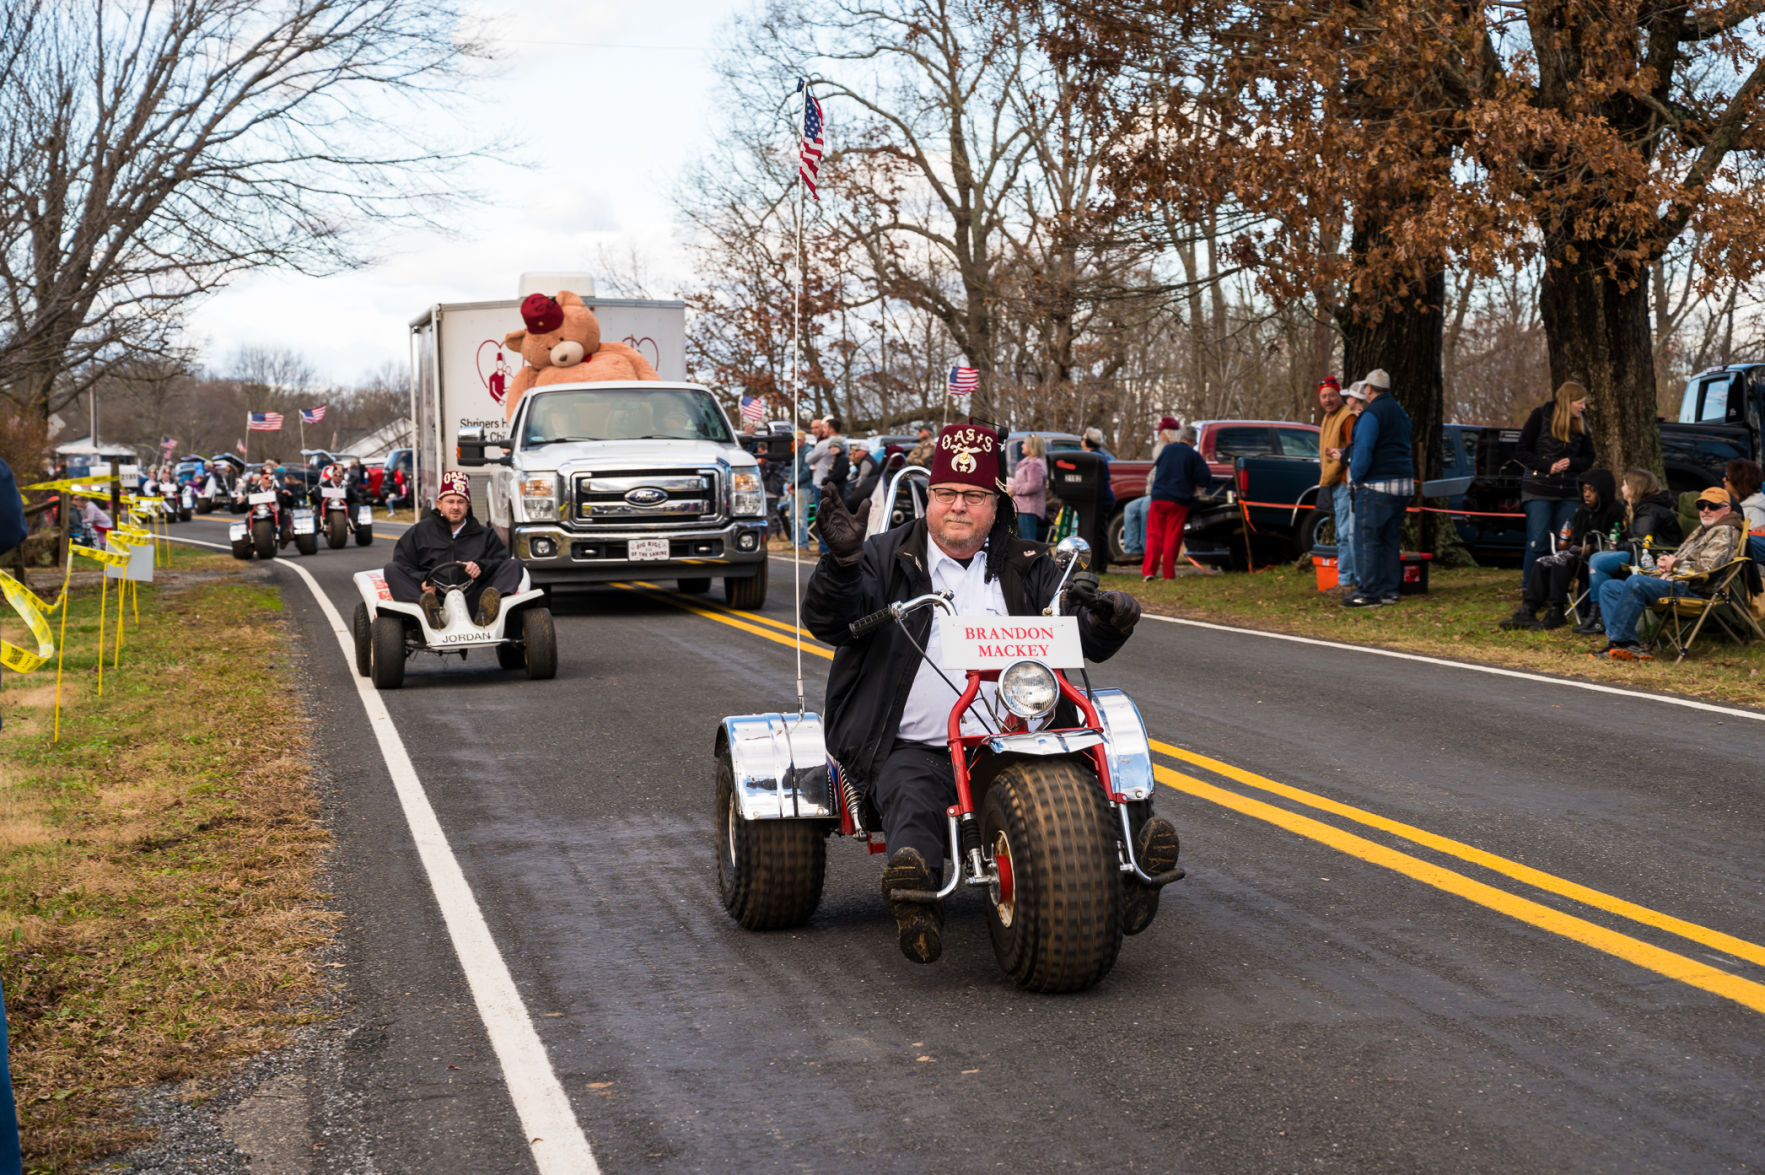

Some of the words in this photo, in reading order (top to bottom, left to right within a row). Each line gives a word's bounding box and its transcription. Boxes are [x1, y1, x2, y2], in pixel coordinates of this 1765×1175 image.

[942, 428, 994, 453] OASIS
[442, 632, 491, 644] JORDAN
[965, 627, 1054, 640] BRANDON
[978, 644, 1049, 657] MACKEY
